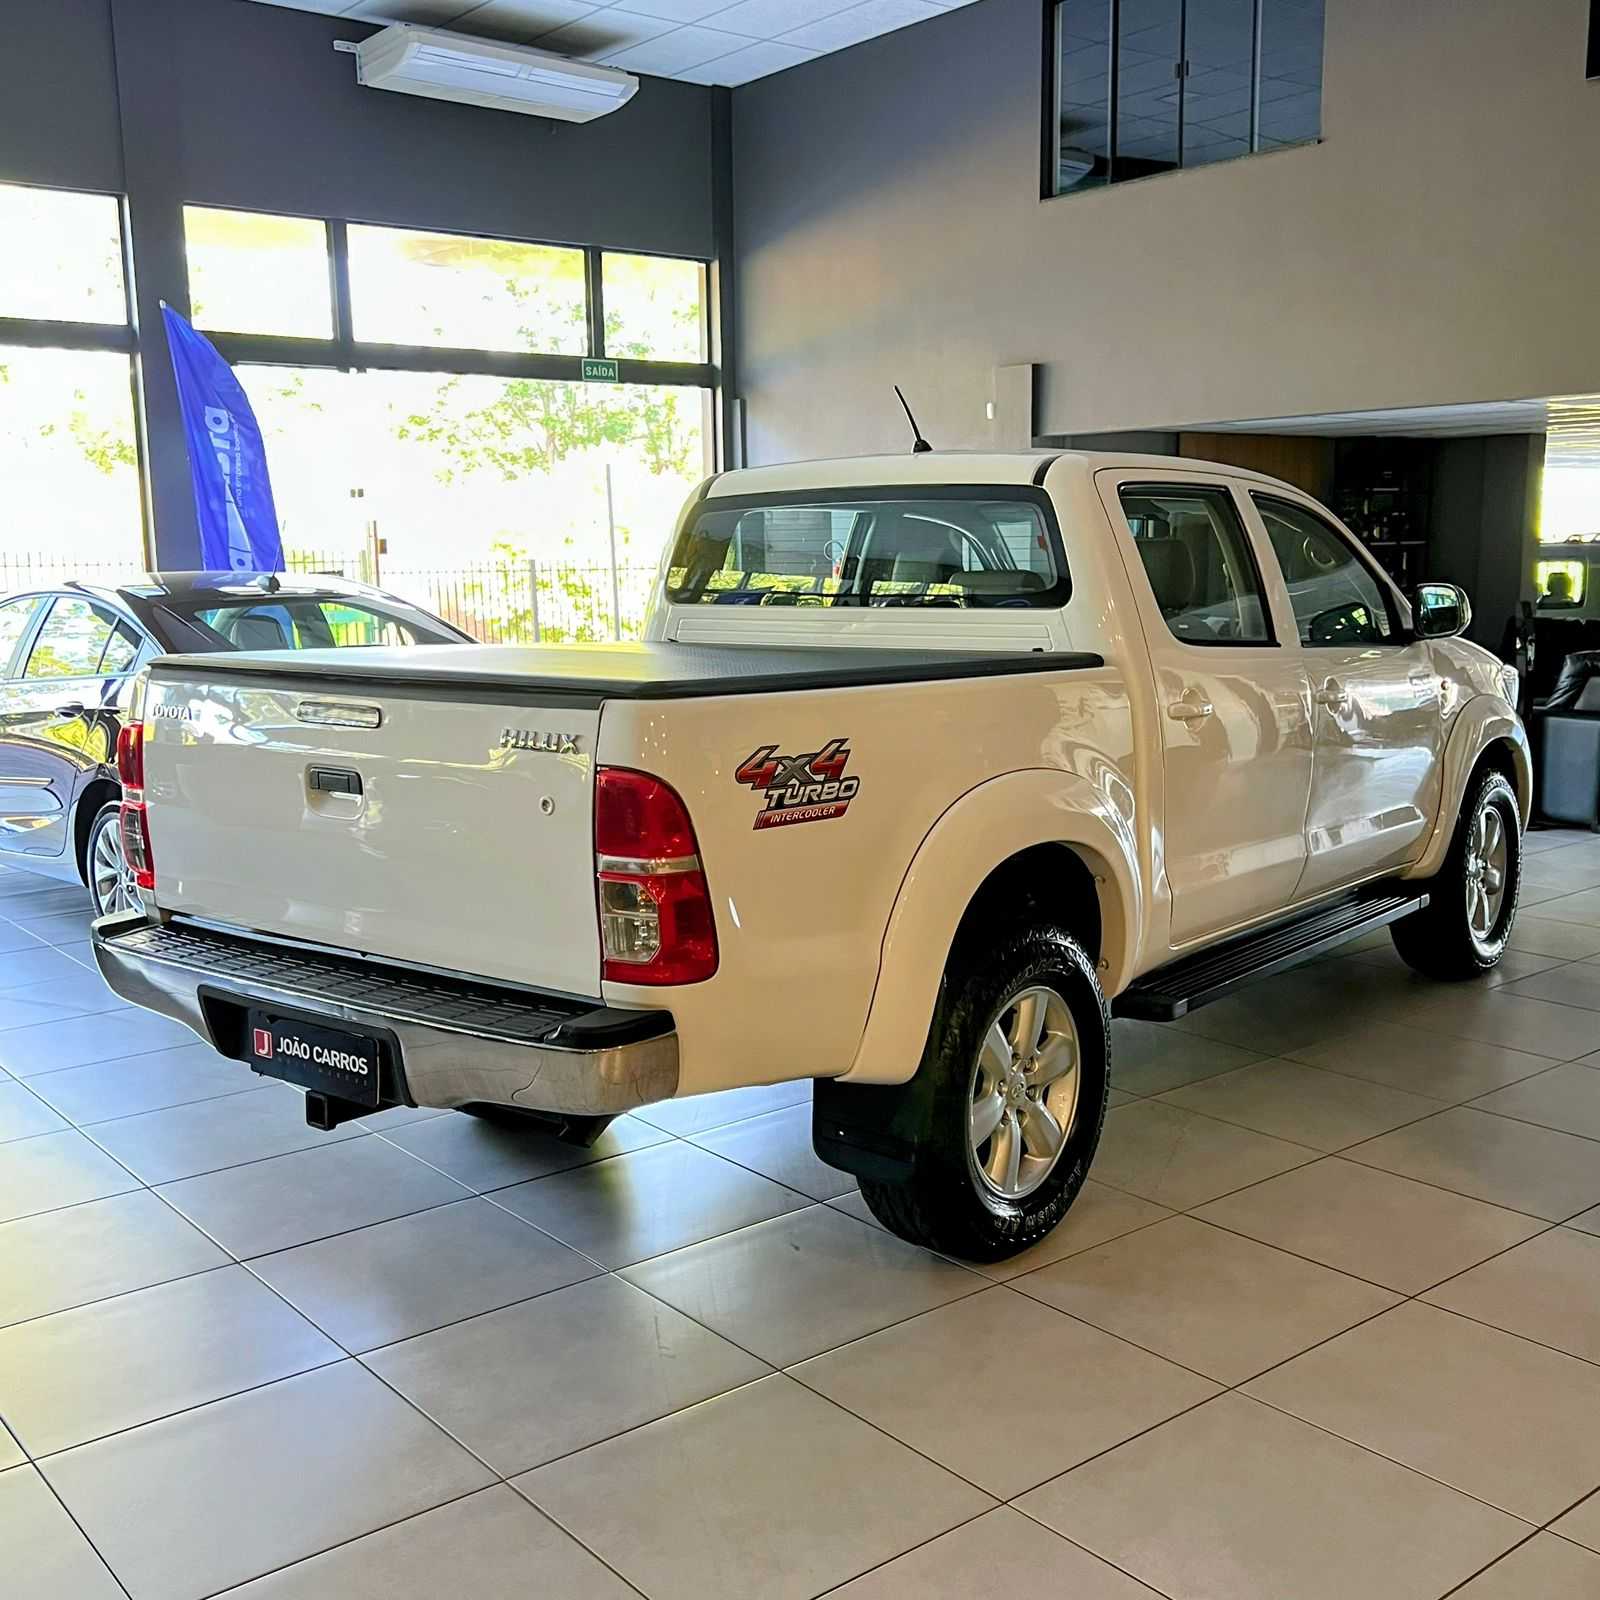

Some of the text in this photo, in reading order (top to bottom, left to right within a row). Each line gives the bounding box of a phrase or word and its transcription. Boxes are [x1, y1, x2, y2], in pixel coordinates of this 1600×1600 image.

[585, 365, 615, 377] SAÍDA
[151, 703, 192, 720] TOYOTA
[499, 728, 578, 754] HILUX
[766, 777, 860, 809] TURBO
[770, 805, 836, 823] INTERCOOLER
[276, 1036, 310, 1060] JOÃO
[313, 1046, 369, 1075] CARROS
